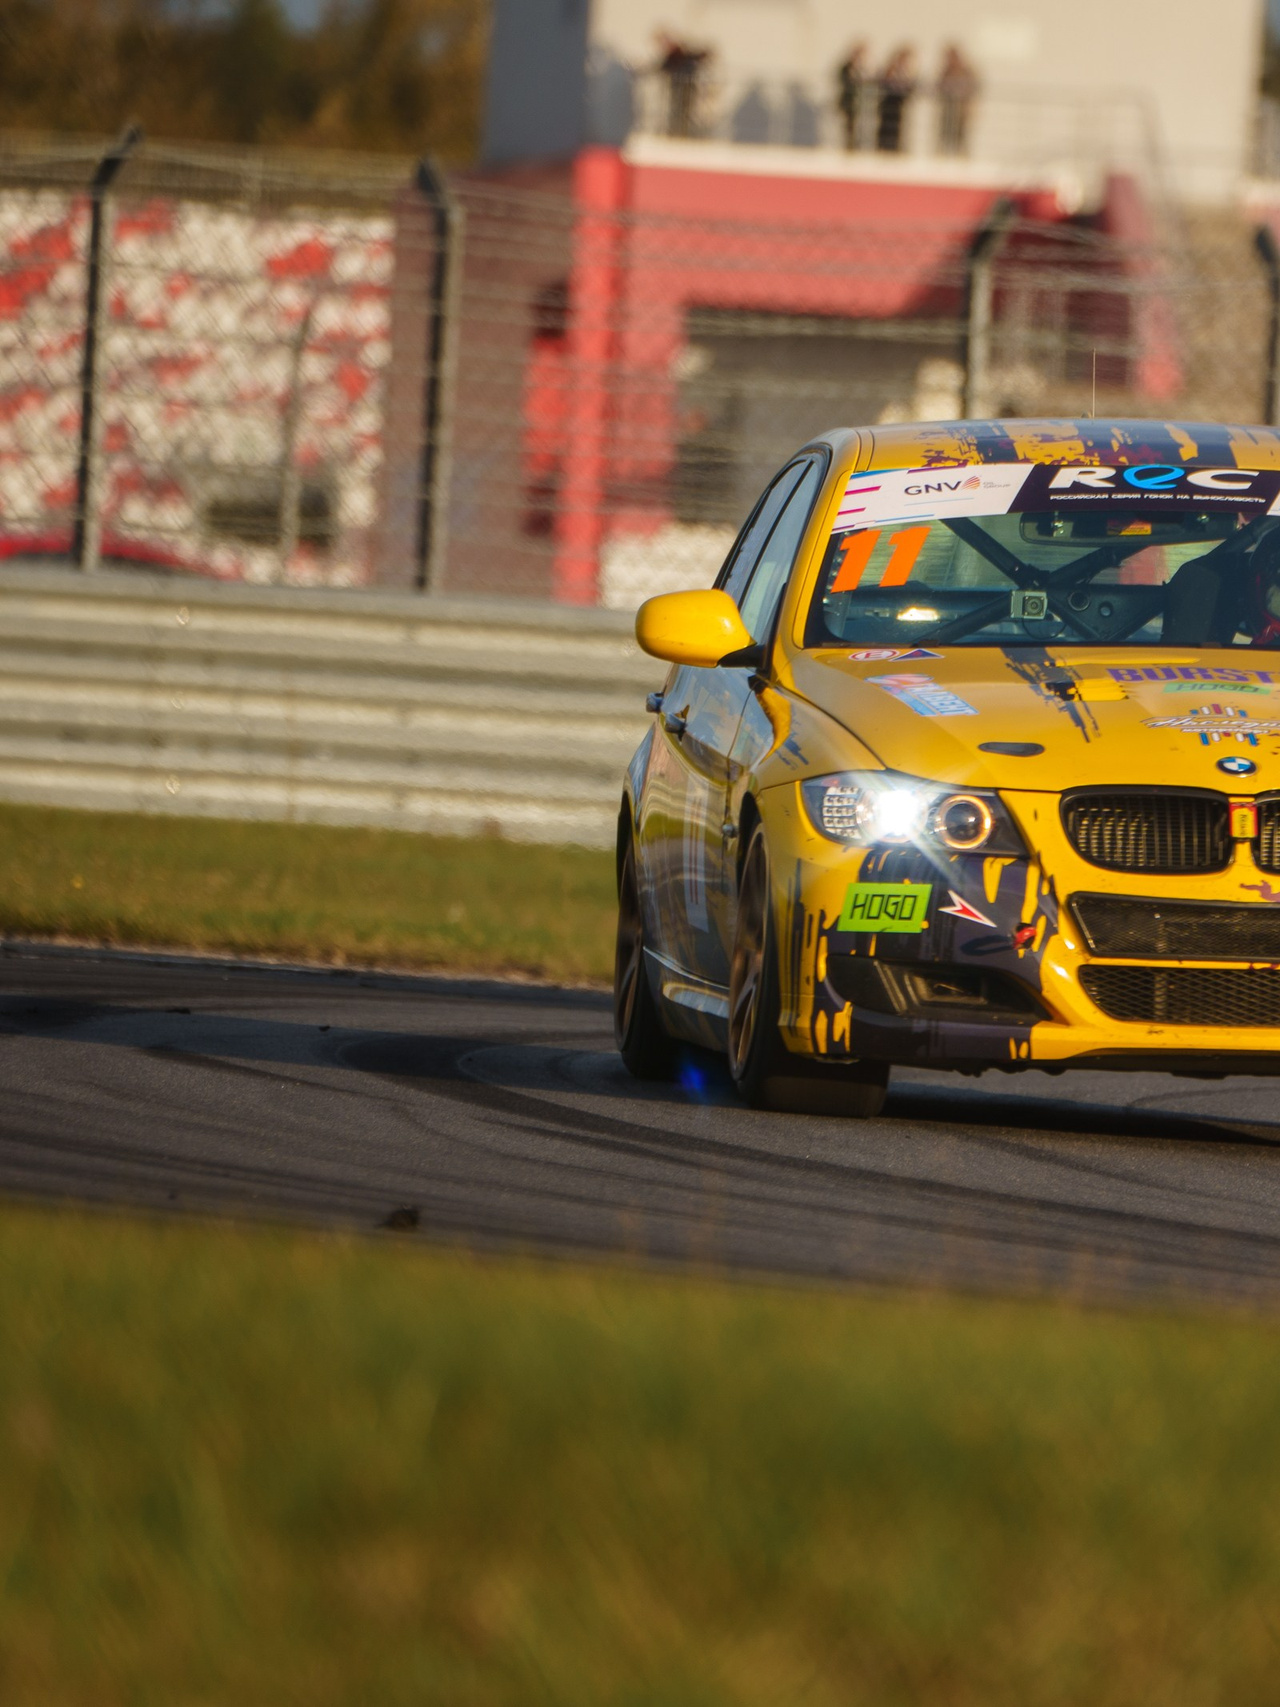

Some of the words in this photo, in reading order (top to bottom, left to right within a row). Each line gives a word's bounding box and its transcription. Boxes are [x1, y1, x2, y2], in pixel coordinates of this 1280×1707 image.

[904, 480, 962, 495] GNV
[830, 526, 932, 594] 11
[1176, 683, 1260, 693] HOGO
[849, 893, 919, 921] HOGO
